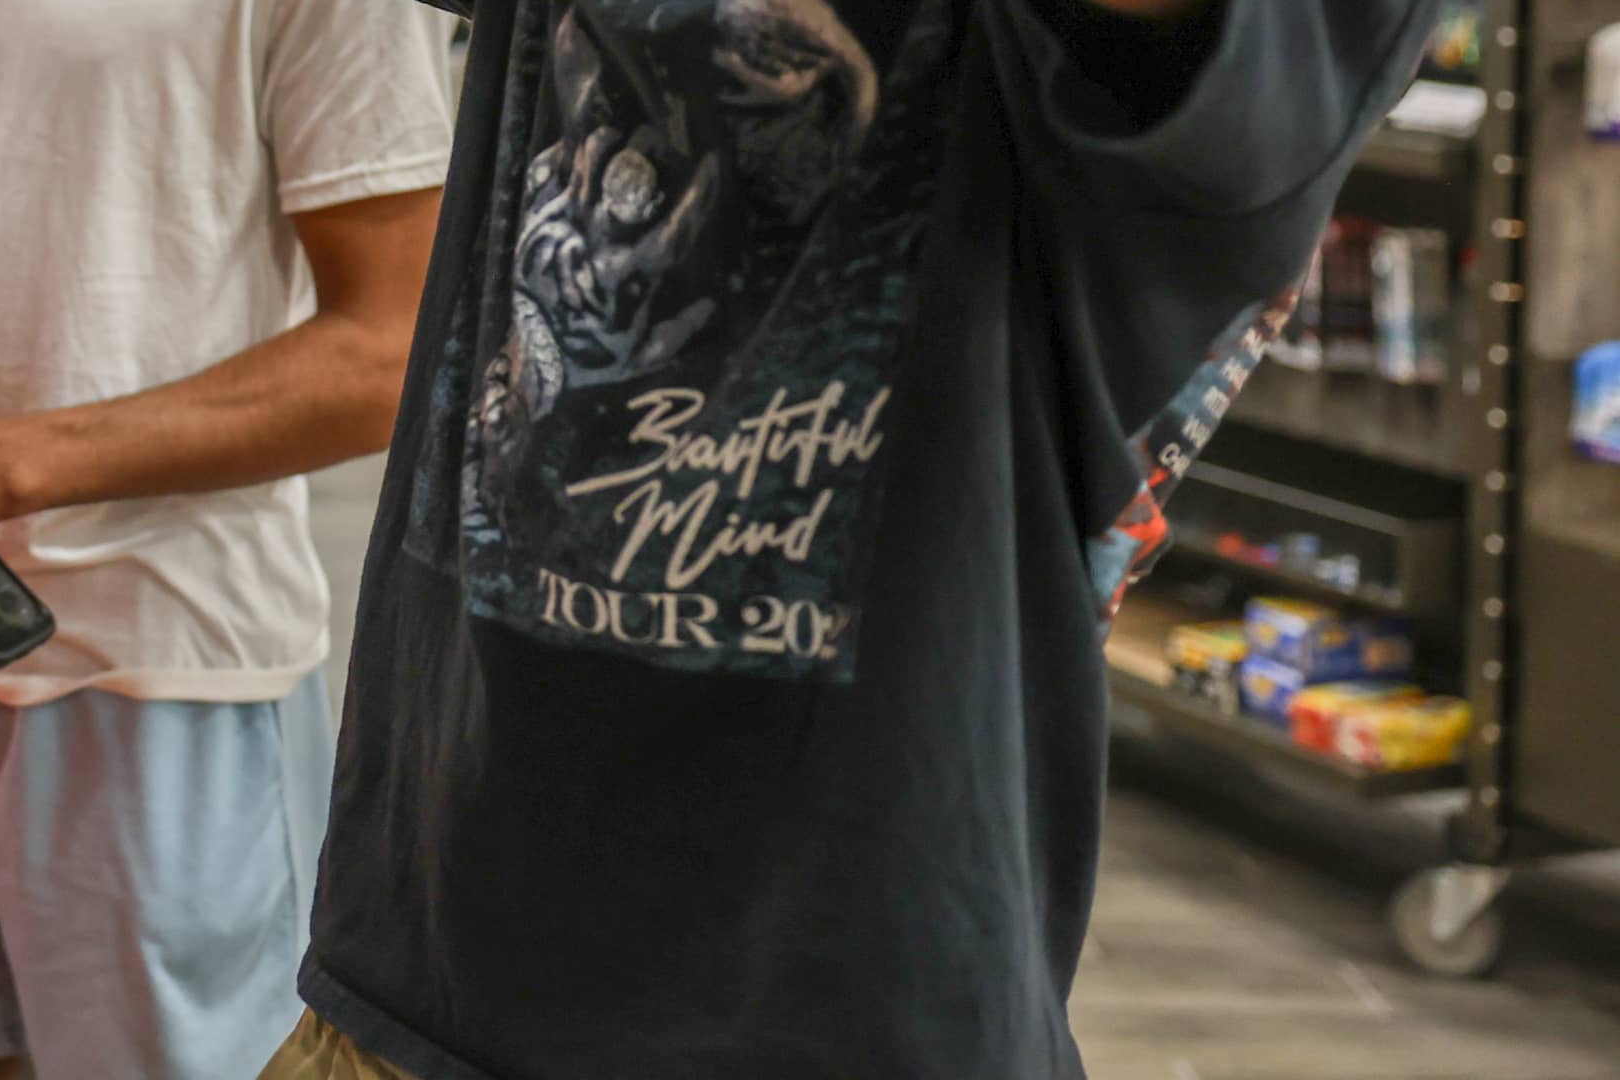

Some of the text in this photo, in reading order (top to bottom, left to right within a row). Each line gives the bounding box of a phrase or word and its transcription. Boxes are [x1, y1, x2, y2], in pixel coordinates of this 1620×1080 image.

[565, 379, 891, 501] Beautiful
[614, 479, 833, 589] Mind
[538, 568, 722, 649] TOUR
